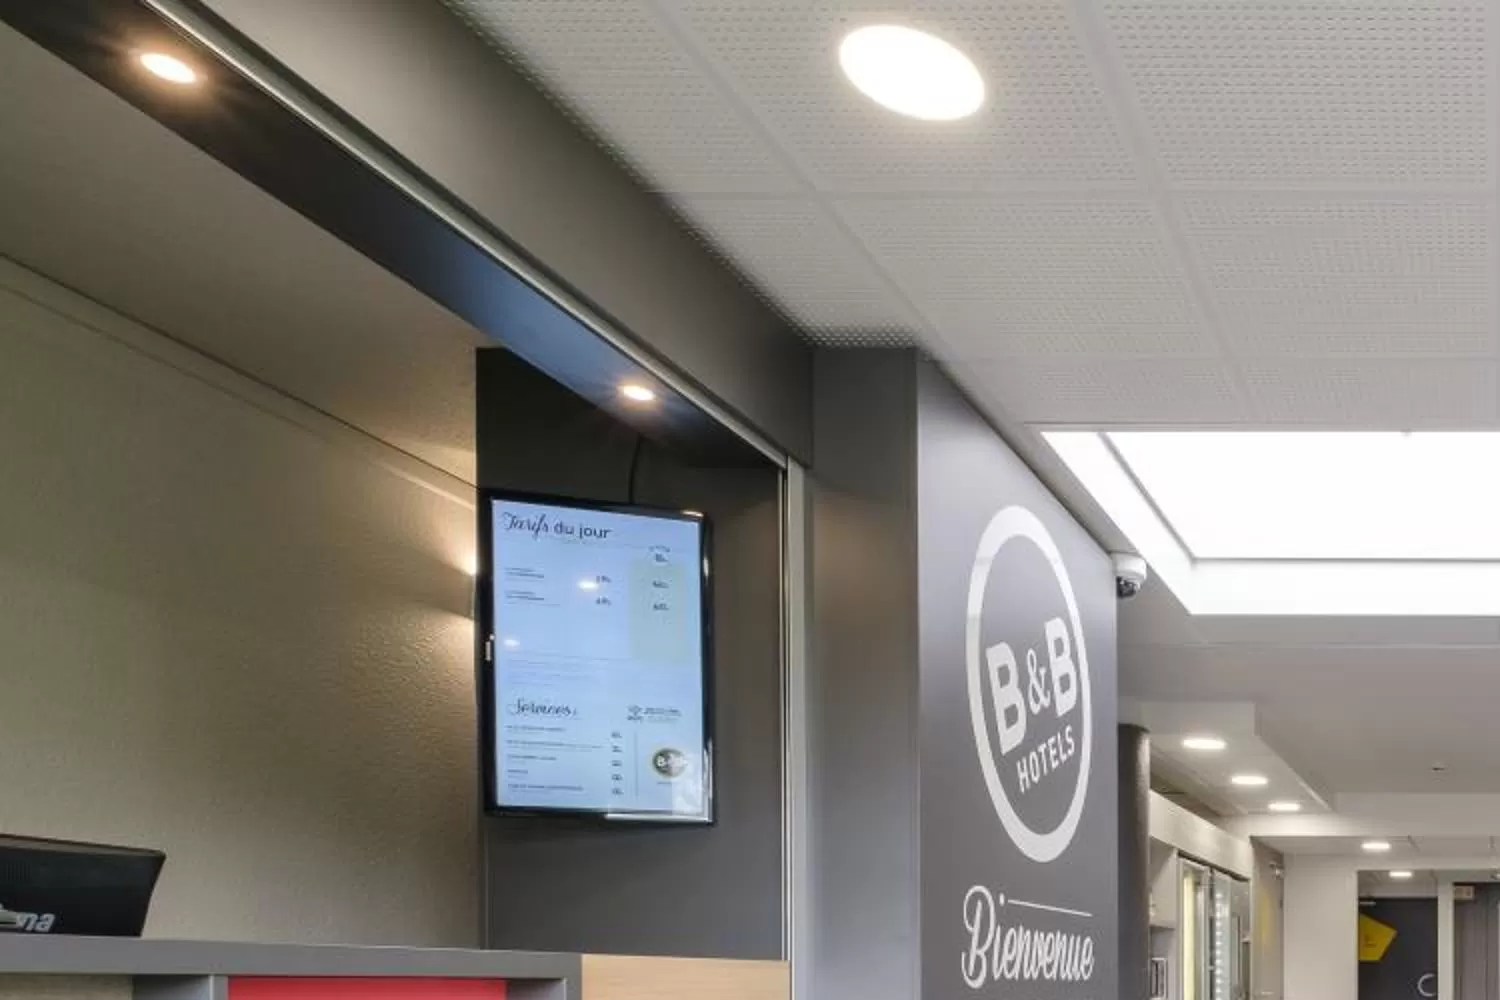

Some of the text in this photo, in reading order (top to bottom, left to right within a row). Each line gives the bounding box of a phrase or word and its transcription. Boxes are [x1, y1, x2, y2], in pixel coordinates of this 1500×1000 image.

[553, 520, 575, 535] du
[579, 524, 612, 539] jour
[985, 616, 1078, 756] B&B
[1016, 724, 1076, 793] HOTELS
[961, 885, 1095, 989] Bienvenue
